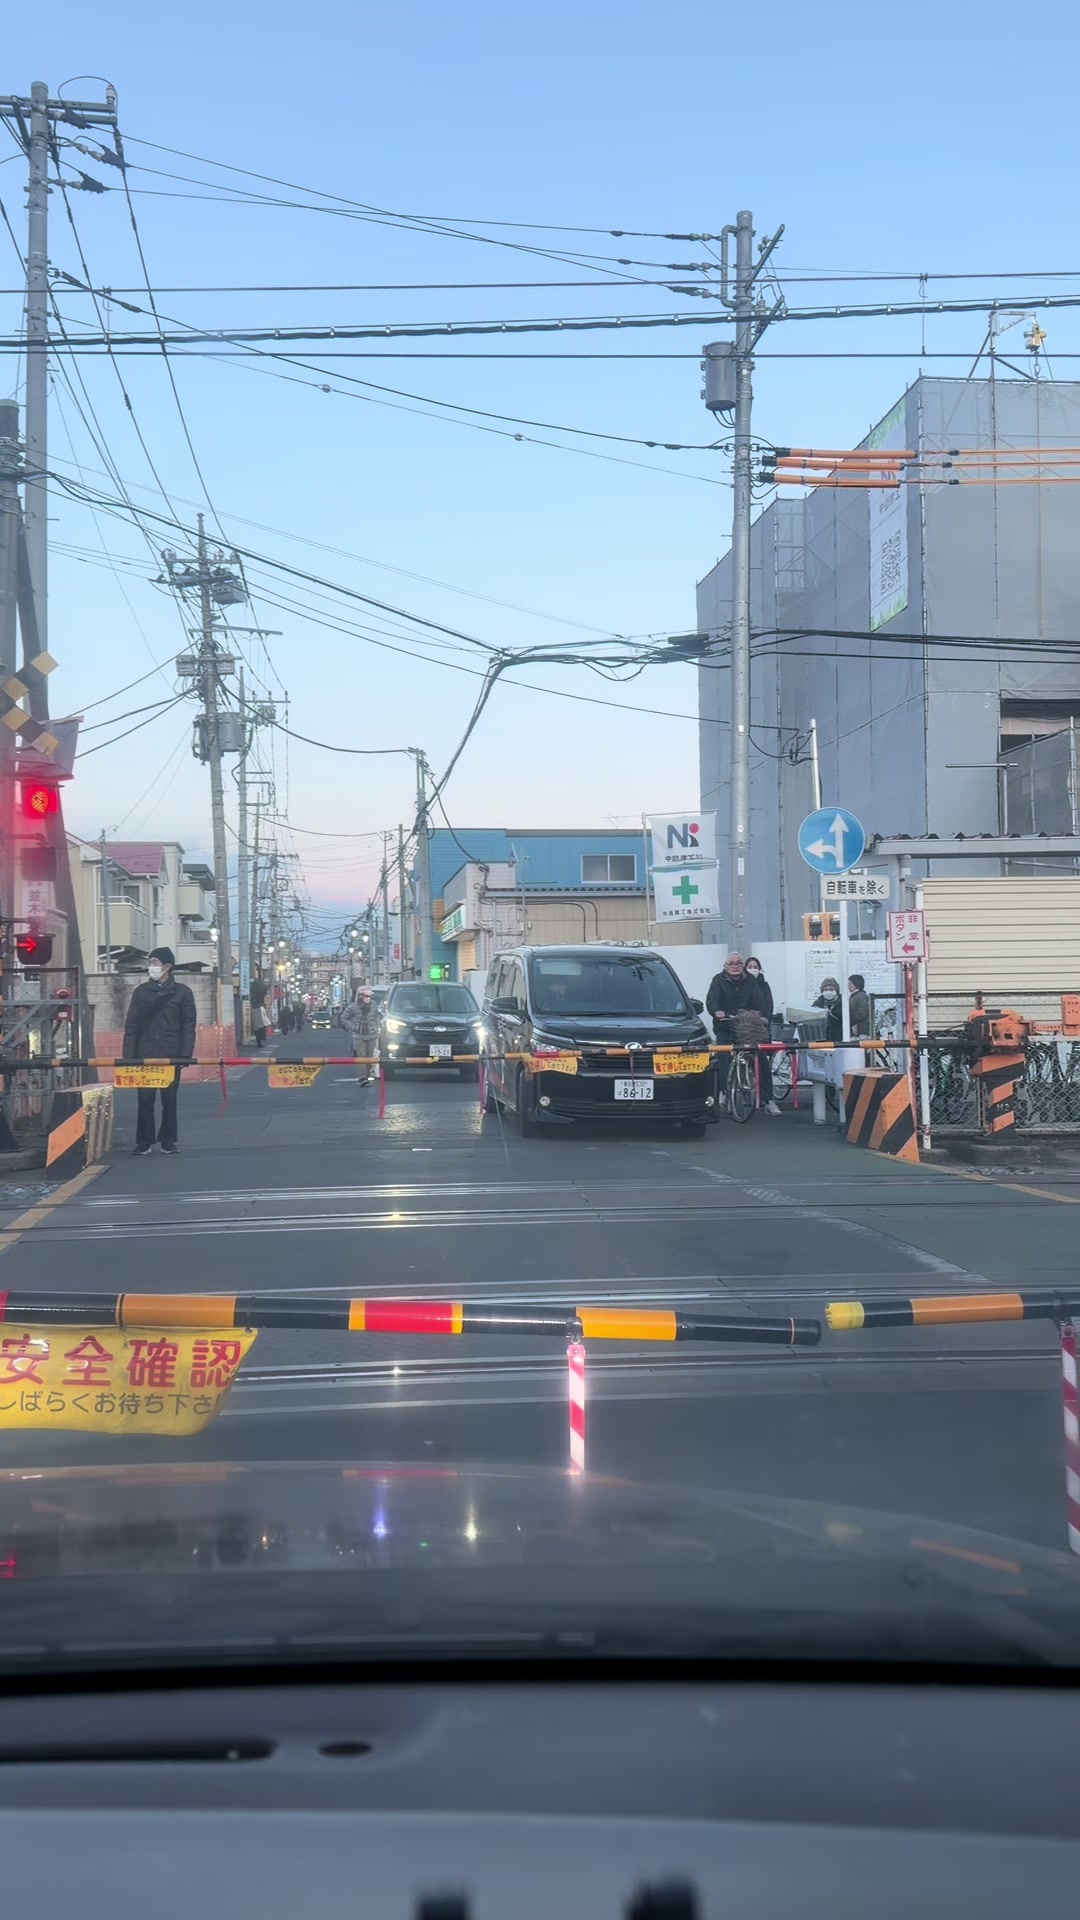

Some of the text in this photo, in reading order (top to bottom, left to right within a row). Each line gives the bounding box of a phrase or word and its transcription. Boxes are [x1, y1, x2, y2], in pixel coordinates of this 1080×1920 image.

[827, 880, 884, 895] 自転車を除く
[895, 915, 905, 941] ボタン
[908, 915, 919, 940] 非常
[623, 1088, 651, 1098] 86-12
[0, 1333, 241, 1388] 安全確認
